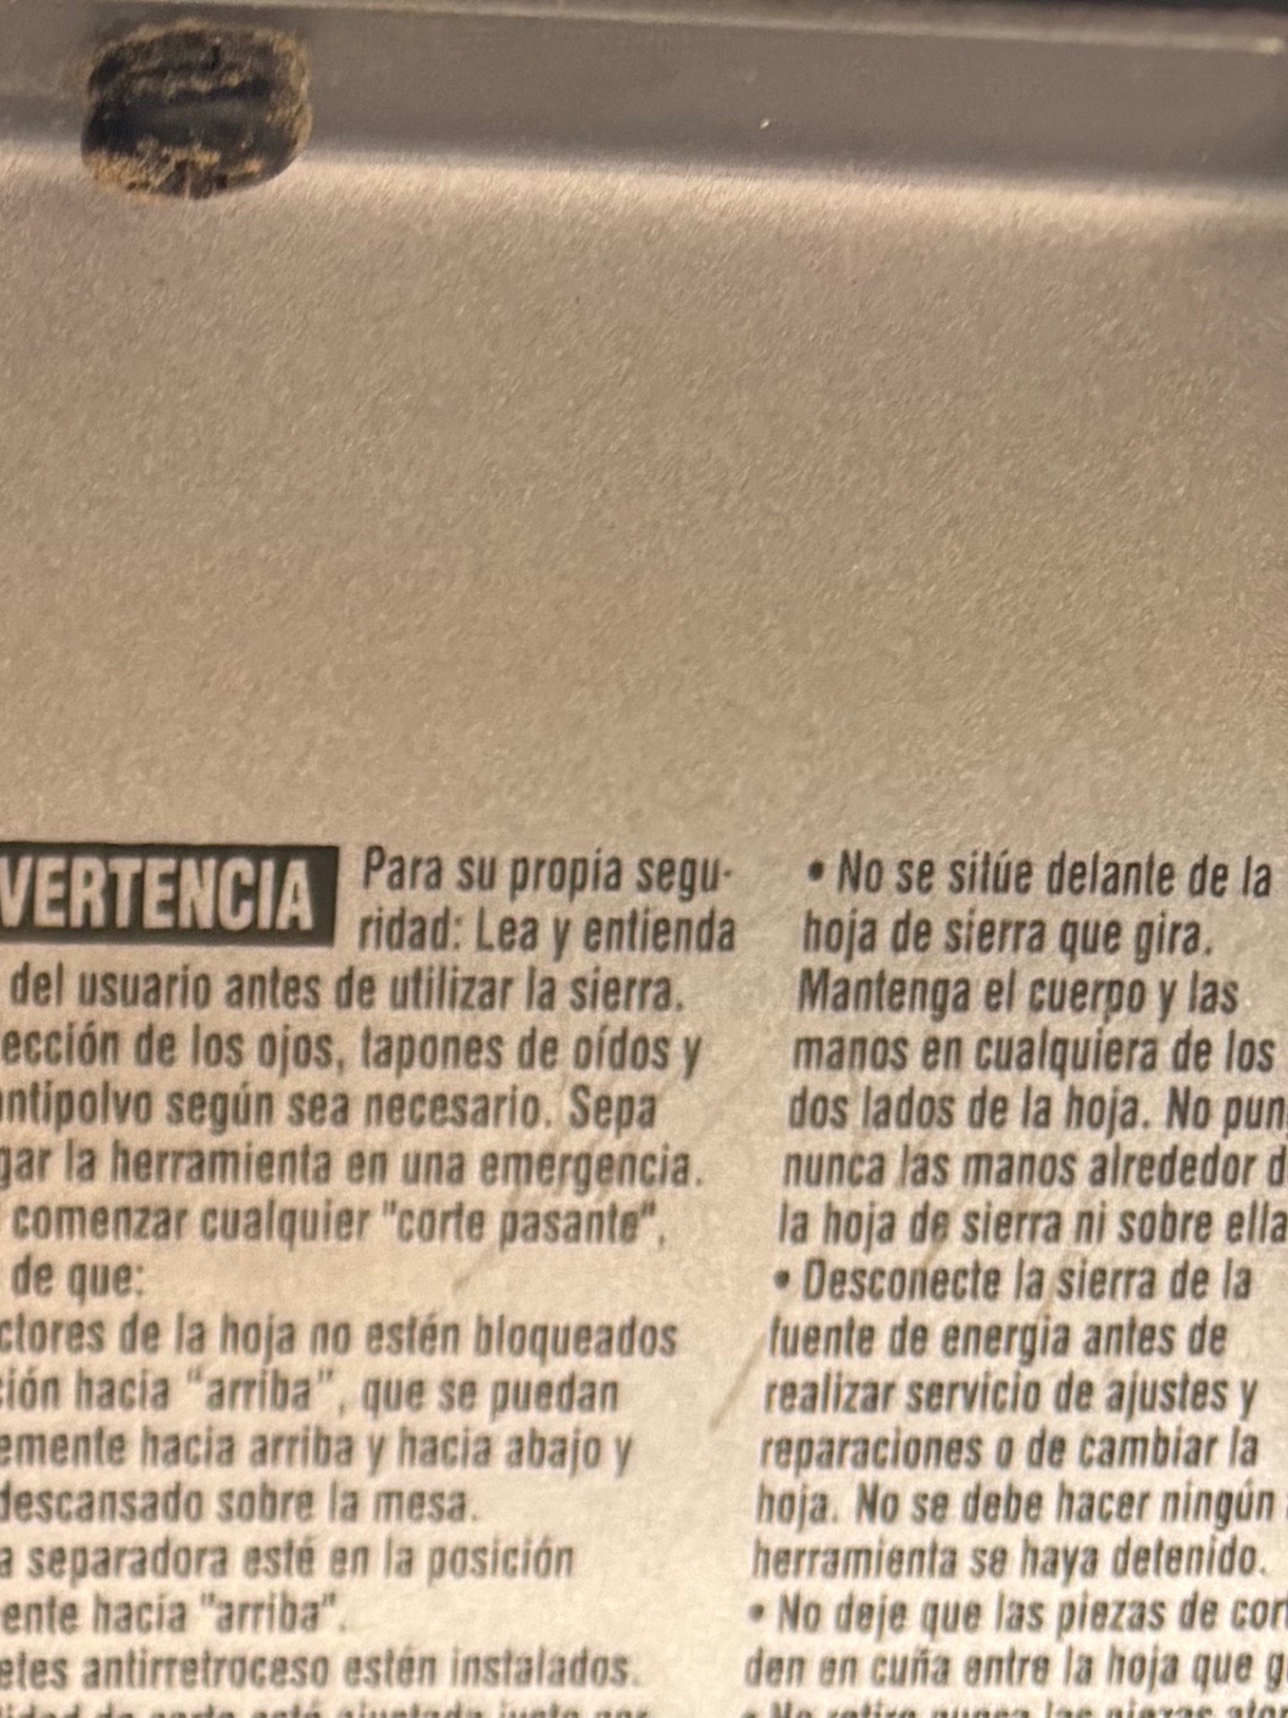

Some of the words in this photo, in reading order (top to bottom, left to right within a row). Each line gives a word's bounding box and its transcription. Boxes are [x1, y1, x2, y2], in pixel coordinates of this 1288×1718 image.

[363, 844, 443, 891] Para
[457, 855, 497, 891] su
[510, 850, 623, 903] propia
[636, 857, 731, 903] segu-
[838, 849, 884, 894] No
[896, 859, 935, 894] se
[948, 849, 1033, 895] sitúe
[1047, 850, 1176, 896] delante
[1188, 854, 1228, 898] de
[1242, 855, 1272, 898] la
[359, 906, 462, 951] ridad:
[476, 906, 539, 952] Lea
[553, 917, 572, 962] y
[583, 906, 736, 953] entienda
[803, 907, 878, 963] hoja
[891, 909, 933, 955] de
[944, 910, 1046, 954] sierra
[1059, 919, 1123, 963] que
[10, 961, 64, 1006] del
[78, 964, 212, 1009] usuario
[225, 965, 322, 1009] antes
[335, 965, 377, 1010] de
[390, 964, 515, 1011] utilizar
[526, 965, 557, 1011] la
[569, 965, 683, 1012] sierra.
[798, 967, 971, 1023] Mantenga
[984, 968, 1017, 1013] el
[1028, 978, 1147, 1024] cuerpo
[1158, 979, 1177, 1024] y
[1188, 970, 1239, 1015] las
[134, 1022, 177, 1067] de
[192, 1023, 244, 1068] los
[258, 1024, 345, 1078] ojos,
[362, 1026, 504, 1079] tapones
[517, 1026, 559, 1070] de
[573, 1023, 671, 1071] oídos
[684, 1036, 703, 1081] y
[794, 1035, 909, 1073] manos
[922, 1035, 963, 1071] en
[975, 1026, 1159, 1081] cualquiera
[1172, 1028, 1213, 1073] de
[1225, 1028, 1276, 1073] los
[167, 1081, 274, 1136] según
[288, 1091, 351, 1127] sea
[365, 1084, 551, 1129] necesario.
[569, 1083, 659, 1138] Sepa
[66, 1138, 98, 1182] la
[112, 1139, 333, 1185] herramienta
[346, 1149, 389, 1184] en
[402, 1150, 466, 1186] una
[480, 1143, 702, 1194] emergencia.
[12, 1203, 189, 1241] comenzar
[201, 1197, 371, 1251] cualquier
[383, 1199, 486, 1242] "corte
[12, 1253, 55, 1296] de
[68, 1262, 144, 1306] que:
[803, 1255, 1002, 1301] Desconecte
[1014, 1257, 1045, 1300] la
[1052, 1257, 1157, 1301] sierra
[1170, 1259, 1210, 1300] de
[1223, 1258, 1253, 1300] la
[120, 1310, 162, 1354] de
[175, 1311, 208, 1354] la
[221, 1312, 297, 1363] hoja
[311, 1321, 352, 1355] no
[366, 1312, 461, 1356] estén
[474, 1314, 679, 1366] bloqueados
[770, 1314, 876, 1358] fuente
[889, 1314, 930, 1357] de
[941, 1312, 1071, 1367] energía
[1083, 1315, 1177, 1357] antes
[1188, 1314, 1229, 1358] de
[753, 1538, 958, 1579] herramienta
[970, 1546, 1009, 1579] se
[1021, 1537, 1099, 1586] haya
[1112, 1535, 1265, 1578] detenido.
[93, 1592, 188, 1634] hacia
